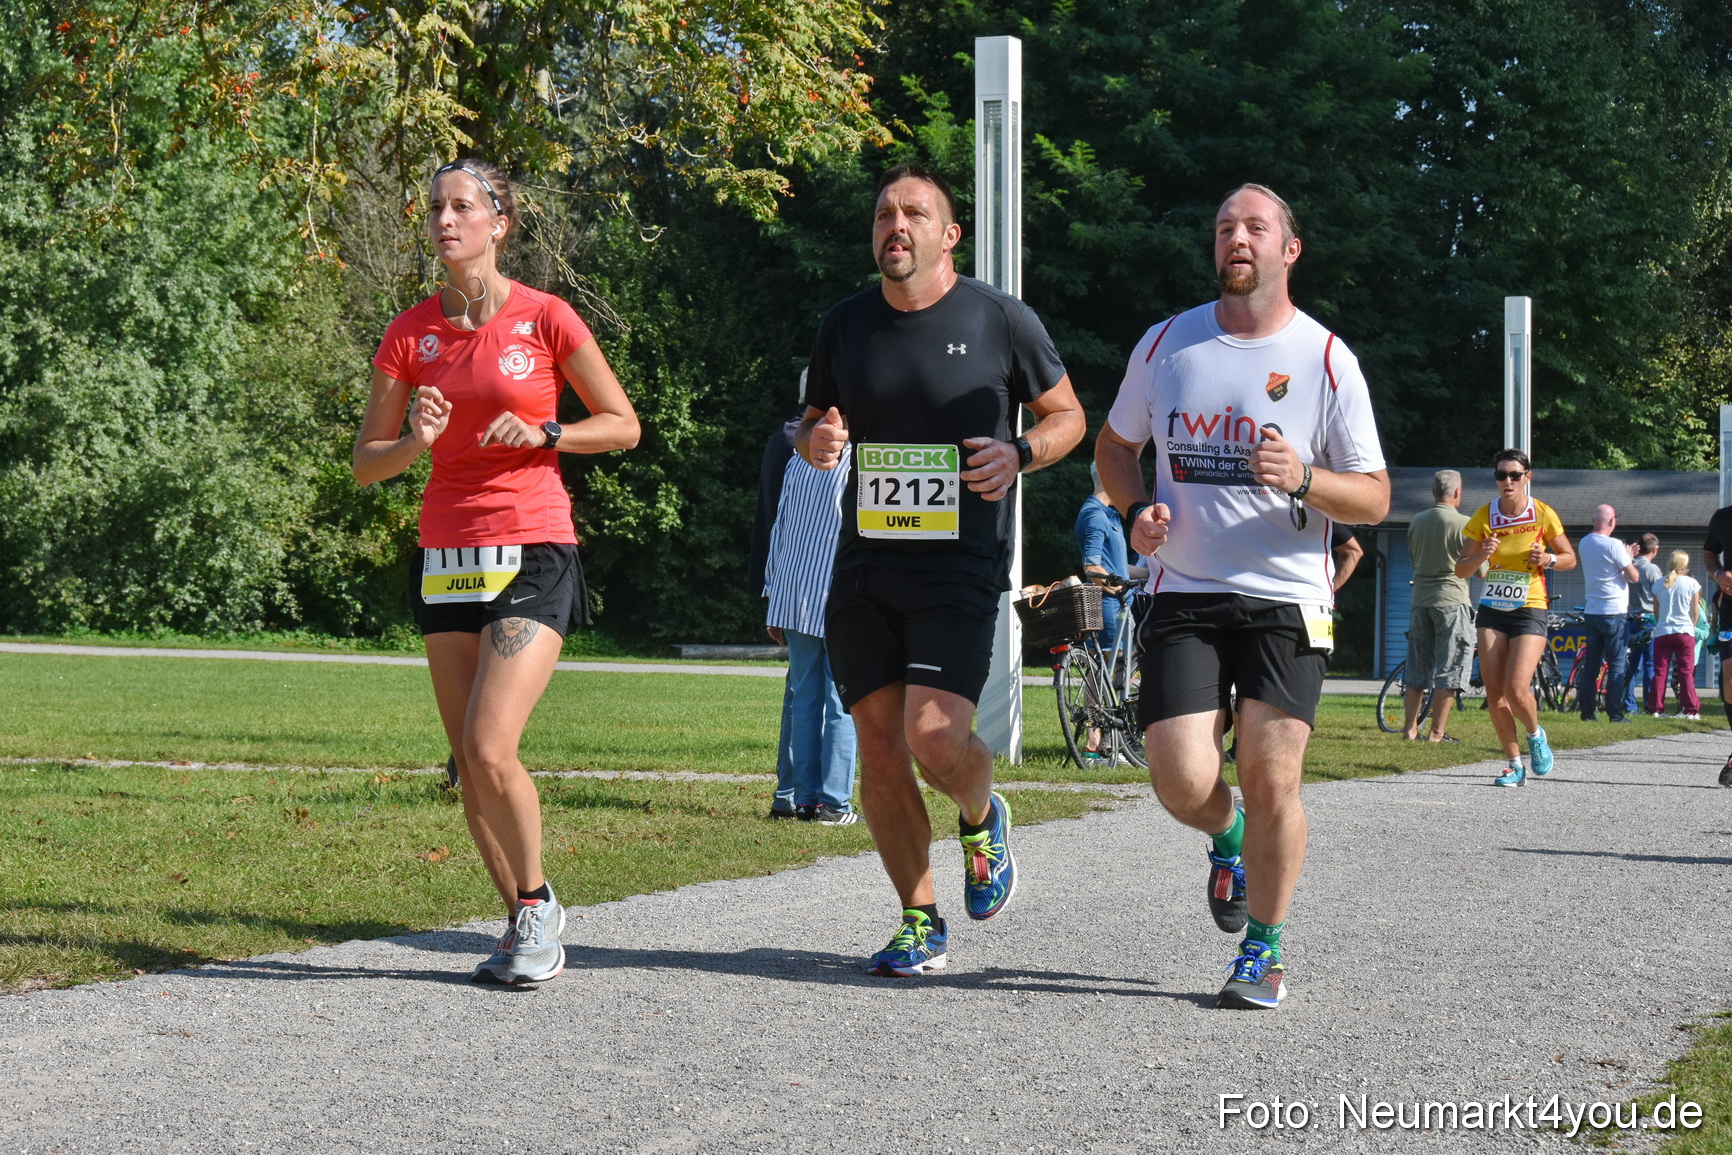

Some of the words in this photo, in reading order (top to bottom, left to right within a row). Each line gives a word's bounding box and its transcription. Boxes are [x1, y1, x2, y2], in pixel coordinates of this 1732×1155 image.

[1167, 441, 1220, 455] Consulting
[1223, 444, 1232, 454] &
[1233, 446, 1251, 456] Aka
[865, 449, 947, 467] BOCK
[1178, 457, 1216, 469] TWINN
[1218, 460, 1236, 471] der
[1239, 461, 1252, 471] Ge
[1194, 469, 1229, 478] persönlich
[869, 478, 945, 505] 1212
[886, 516, 921, 528] UWE
[1513, 525, 1538, 535] BÖGL
[446, 577, 486, 591] JULIA
[1489, 572, 1526, 584] BOCK
[1486, 585, 1522, 599] 2400
[1491, 600, 1514, 608] MARIA
